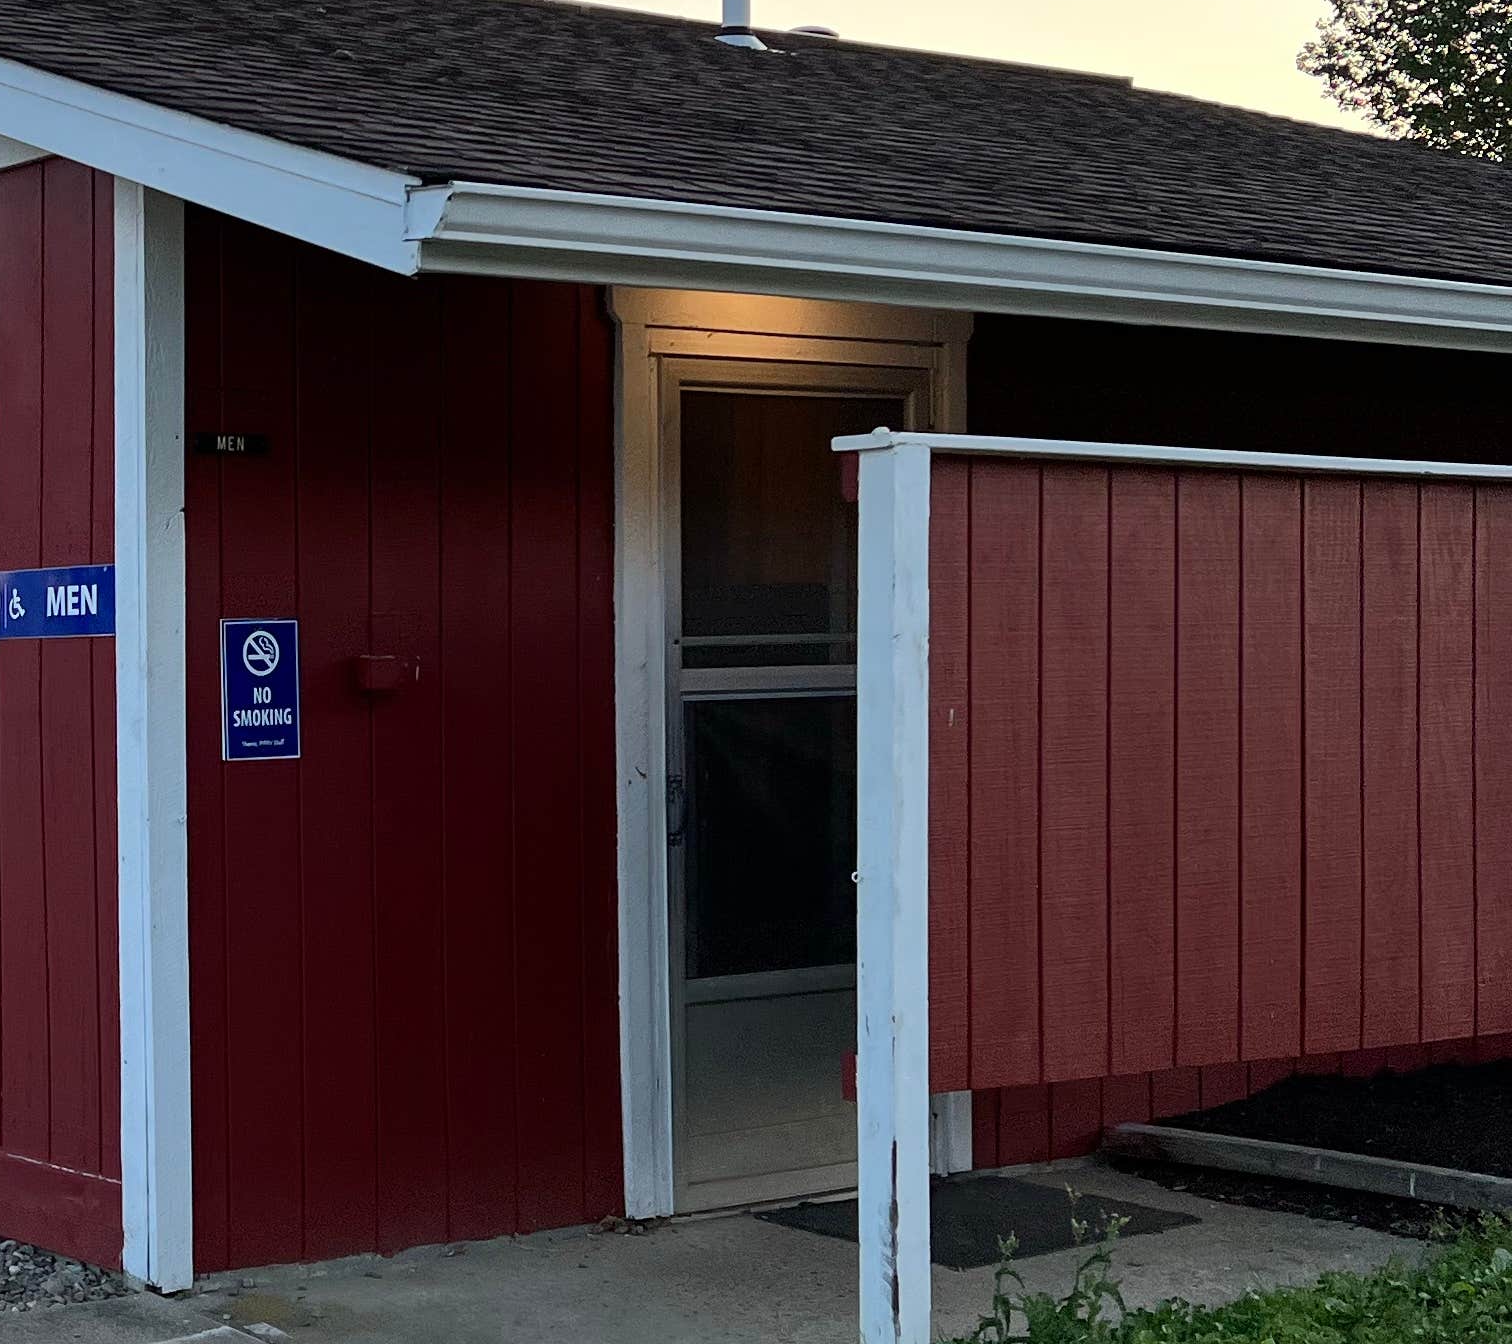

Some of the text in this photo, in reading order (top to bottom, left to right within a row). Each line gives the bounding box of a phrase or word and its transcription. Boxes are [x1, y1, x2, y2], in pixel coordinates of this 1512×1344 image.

[216, 435, 245, 452] MEN
[46, 584, 98, 617] MEN
[253, 686, 272, 705] NO
[233, 708, 292, 728] SMOKING
